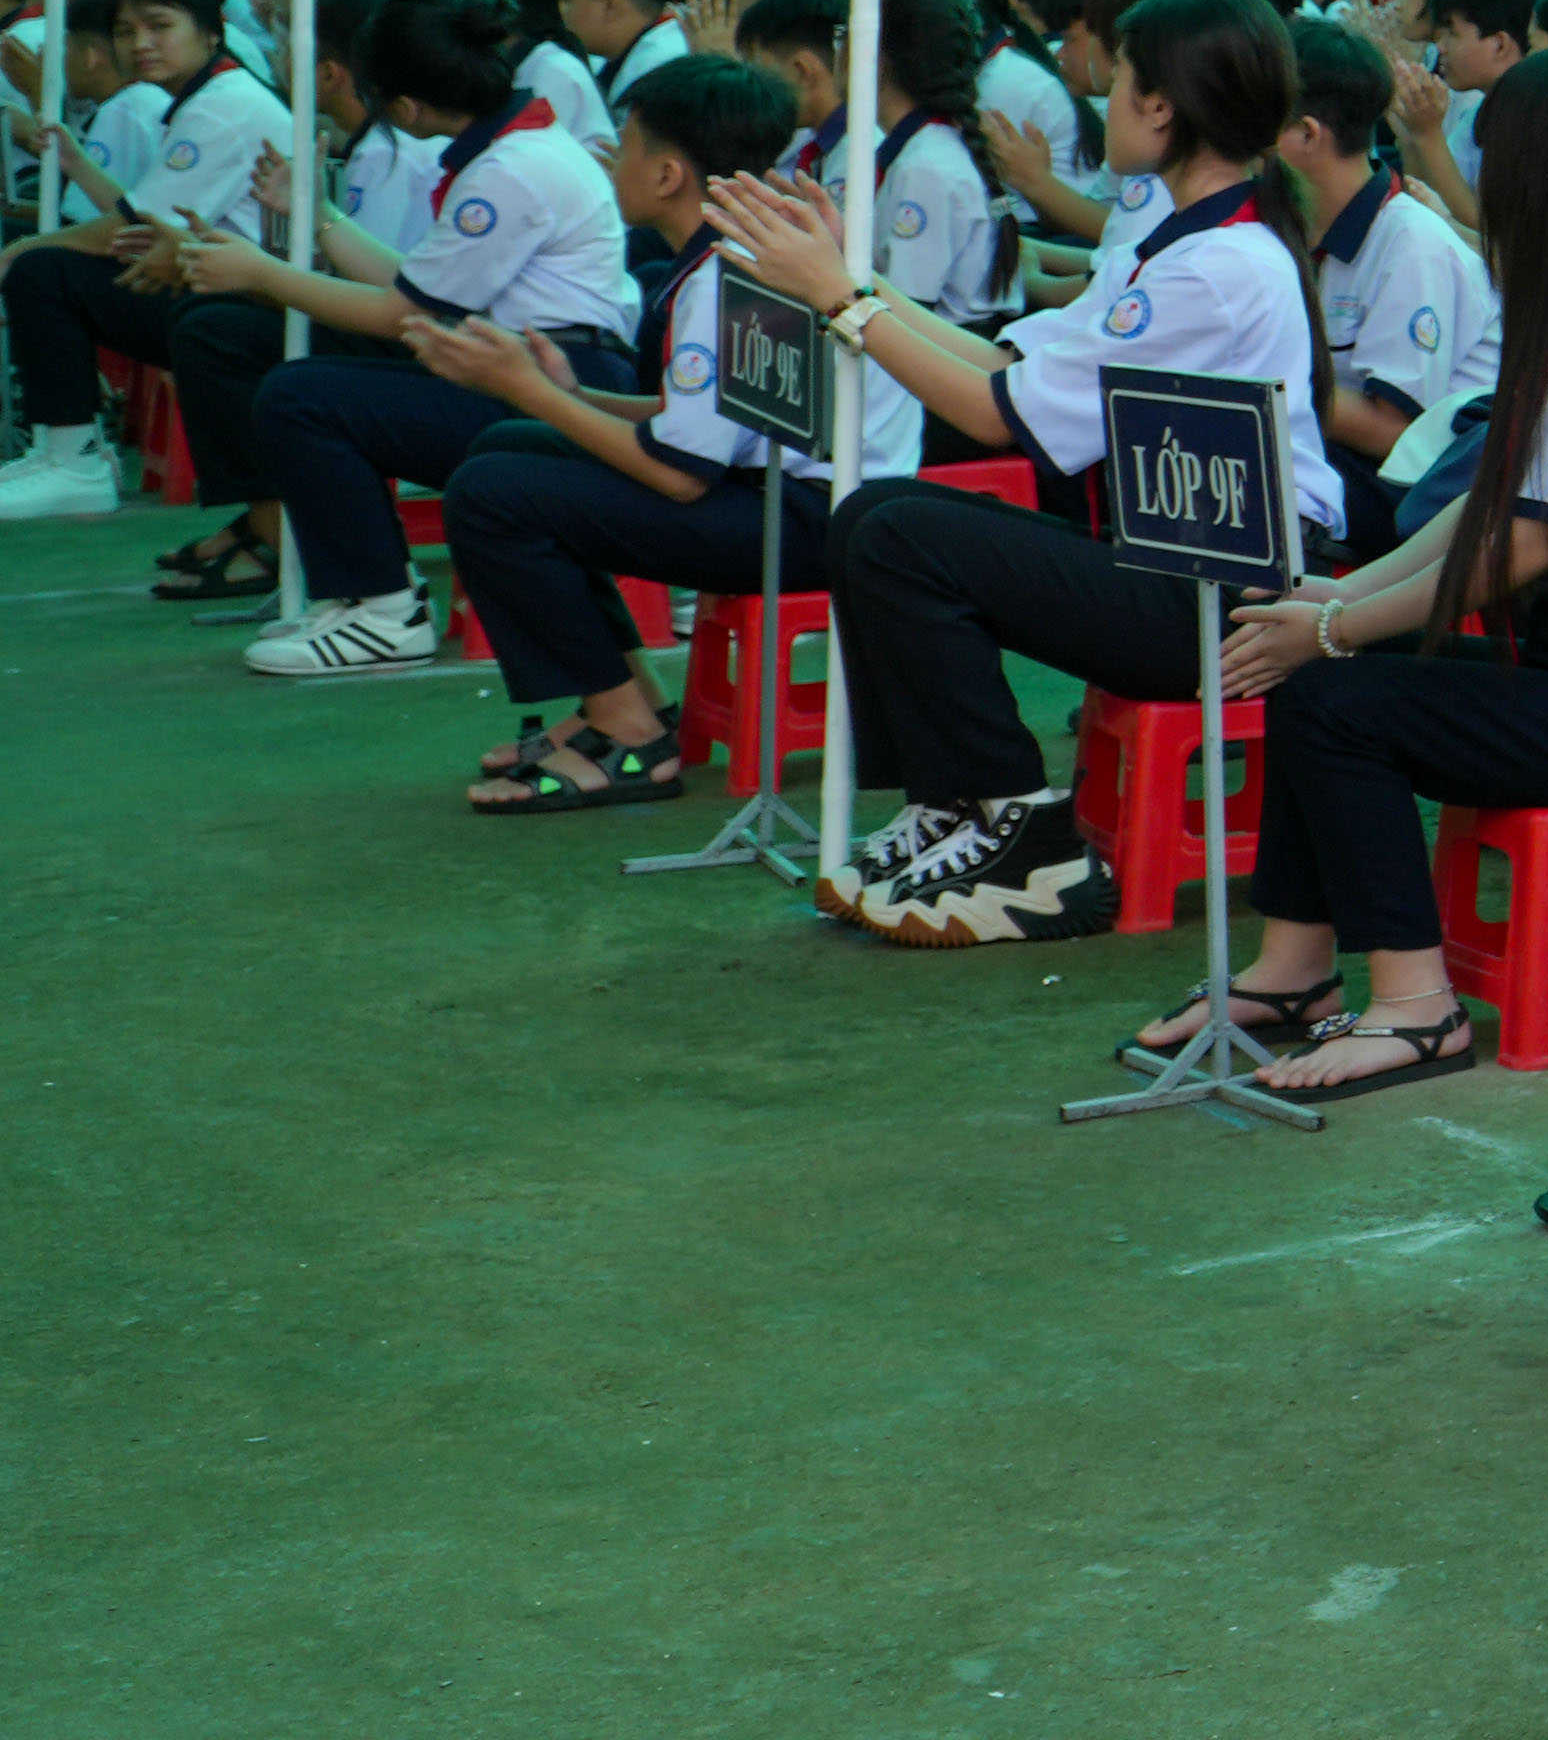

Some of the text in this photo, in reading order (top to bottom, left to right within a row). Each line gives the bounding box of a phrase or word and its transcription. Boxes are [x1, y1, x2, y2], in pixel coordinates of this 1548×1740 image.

[731, 311, 773, 391] LỚP
[776, 341, 802, 407] 9E
[1131, 425, 1248, 529] LỚP 9F
